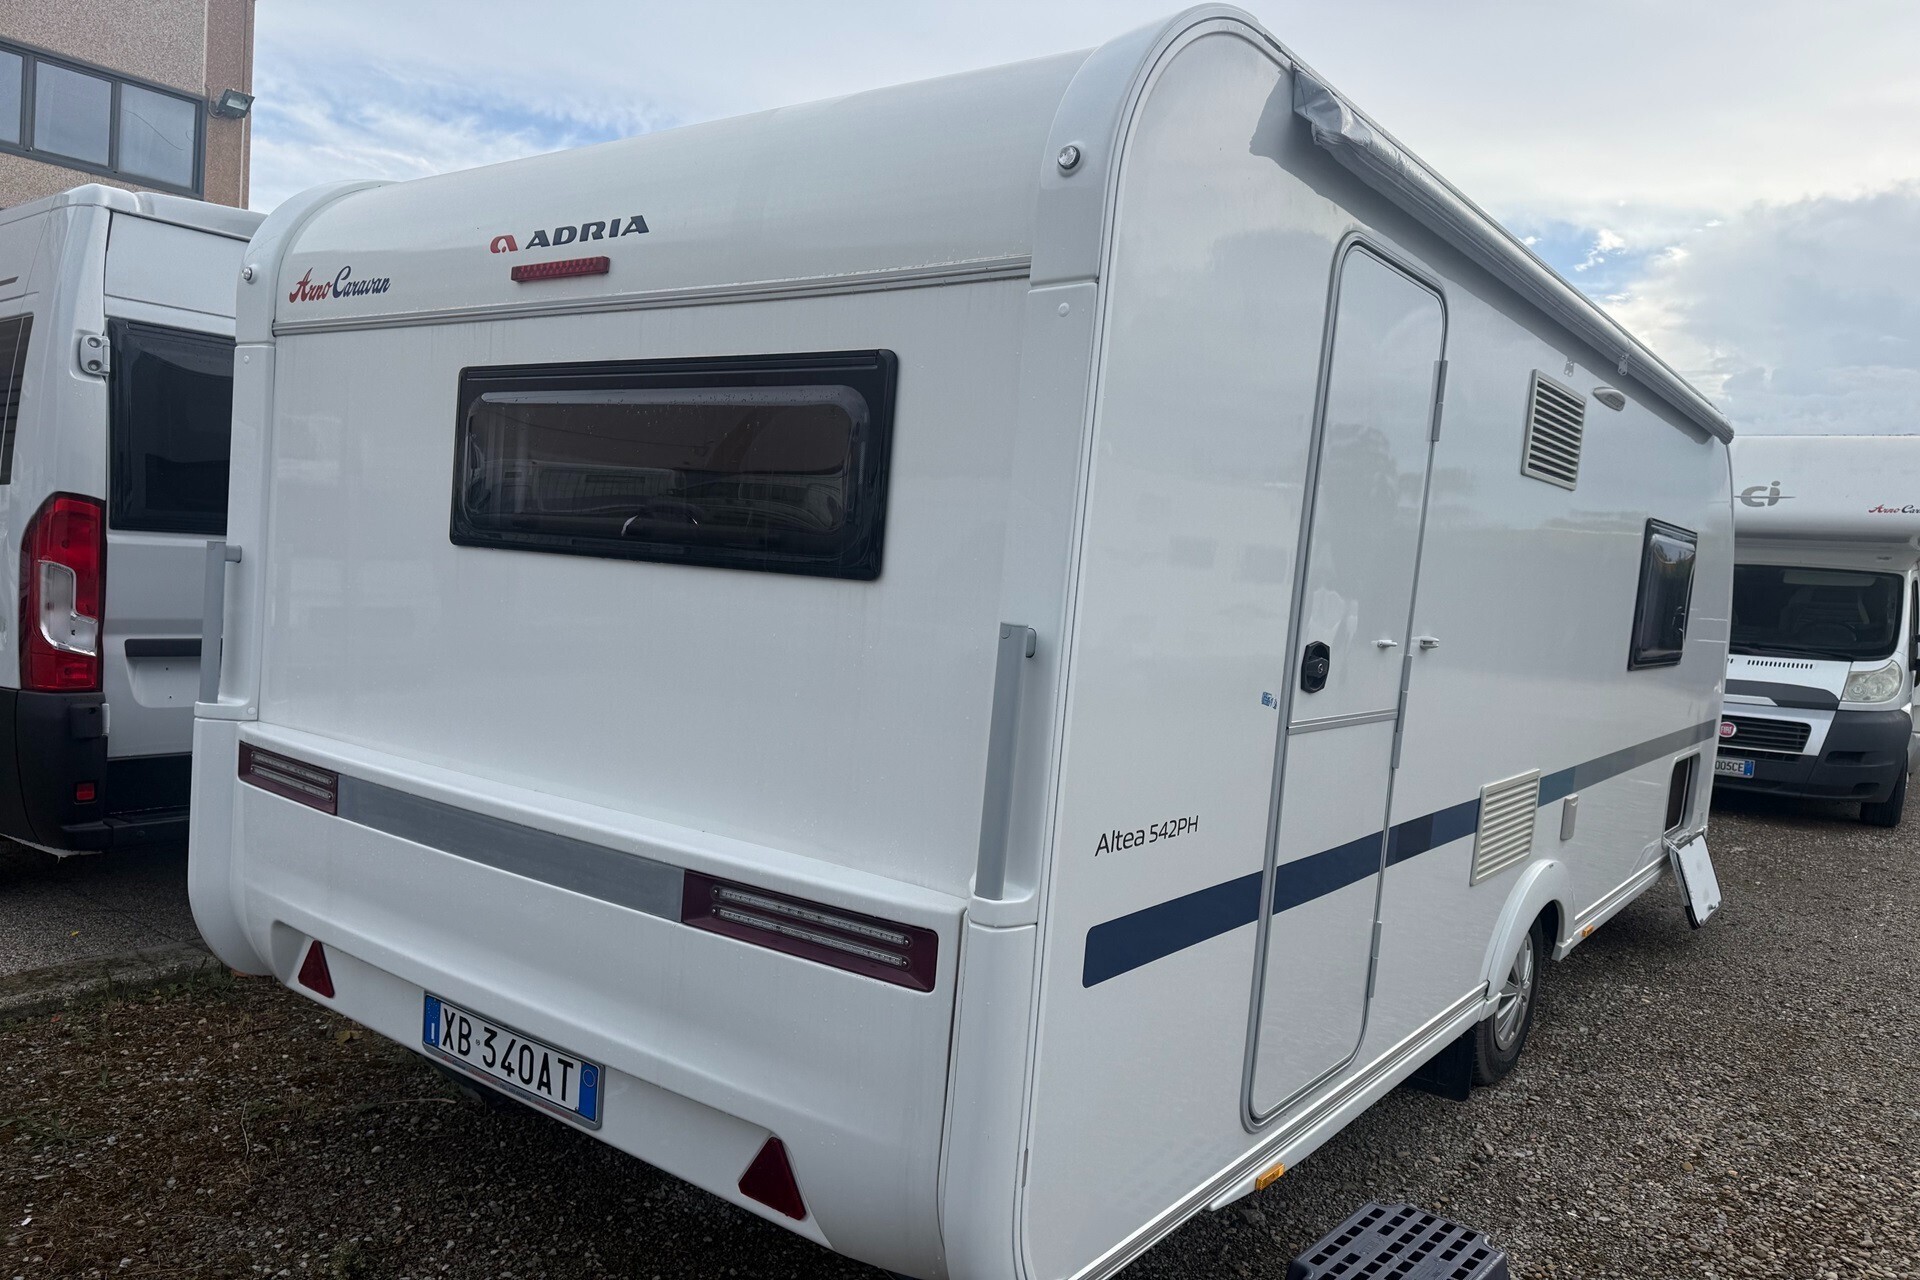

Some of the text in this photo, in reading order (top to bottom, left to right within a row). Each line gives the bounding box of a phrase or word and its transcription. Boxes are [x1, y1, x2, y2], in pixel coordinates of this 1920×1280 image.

[525, 214, 650, 250] ADRIA
[288, 265, 391, 303] Arno Caravan
[1868, 504, 1900, 513] Arno
[1094, 815, 1199, 857] Altea 542PH
[442, 1008, 574, 1102] XB 340AT
